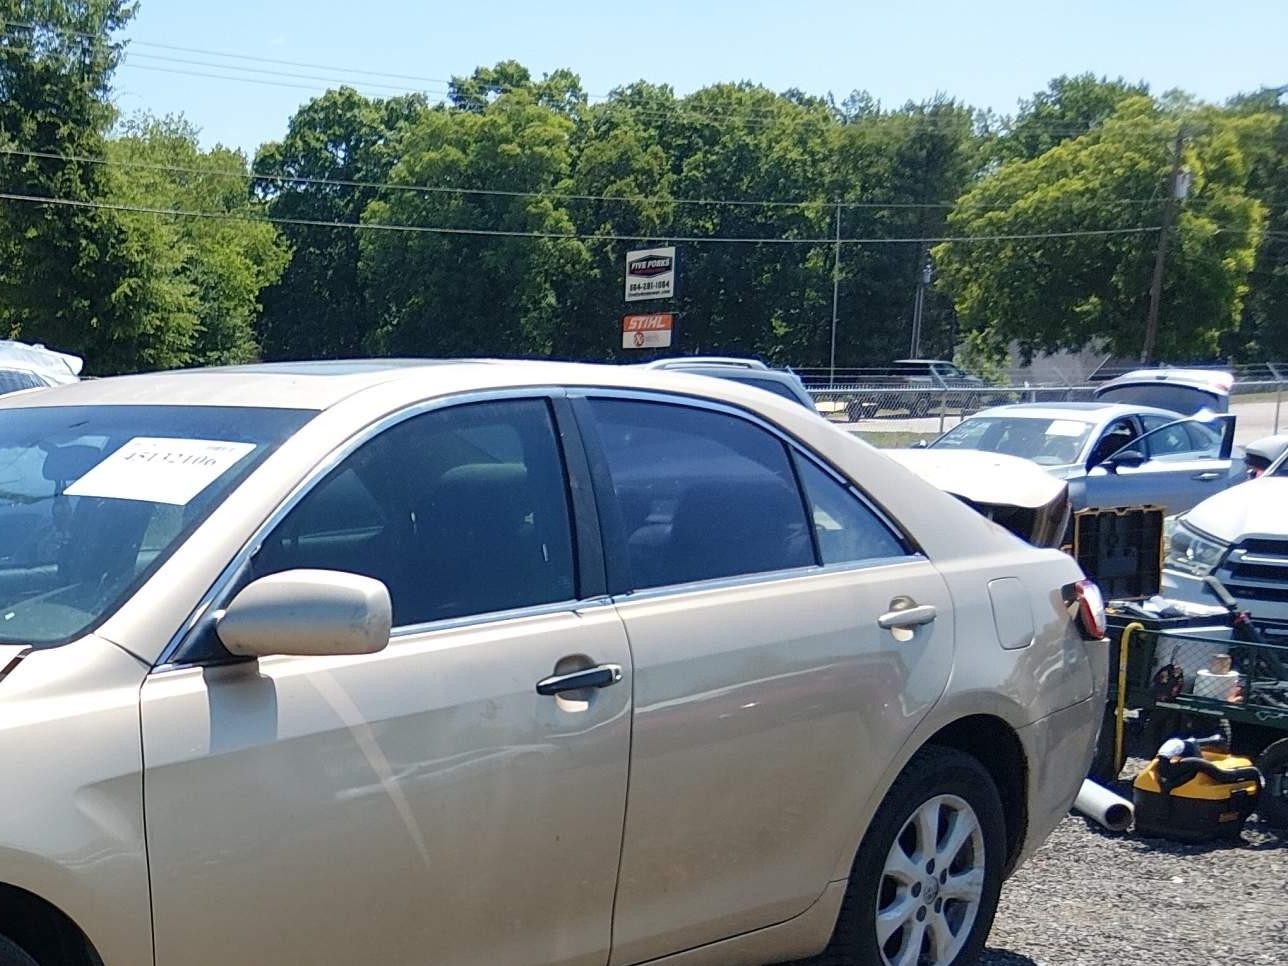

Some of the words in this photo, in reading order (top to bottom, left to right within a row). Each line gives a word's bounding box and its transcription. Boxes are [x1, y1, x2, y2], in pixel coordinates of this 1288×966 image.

[631, 261, 647, 270] FIVE
[647, 258, 669, 267] FORKS
[628, 316, 665, 329] STIHL
